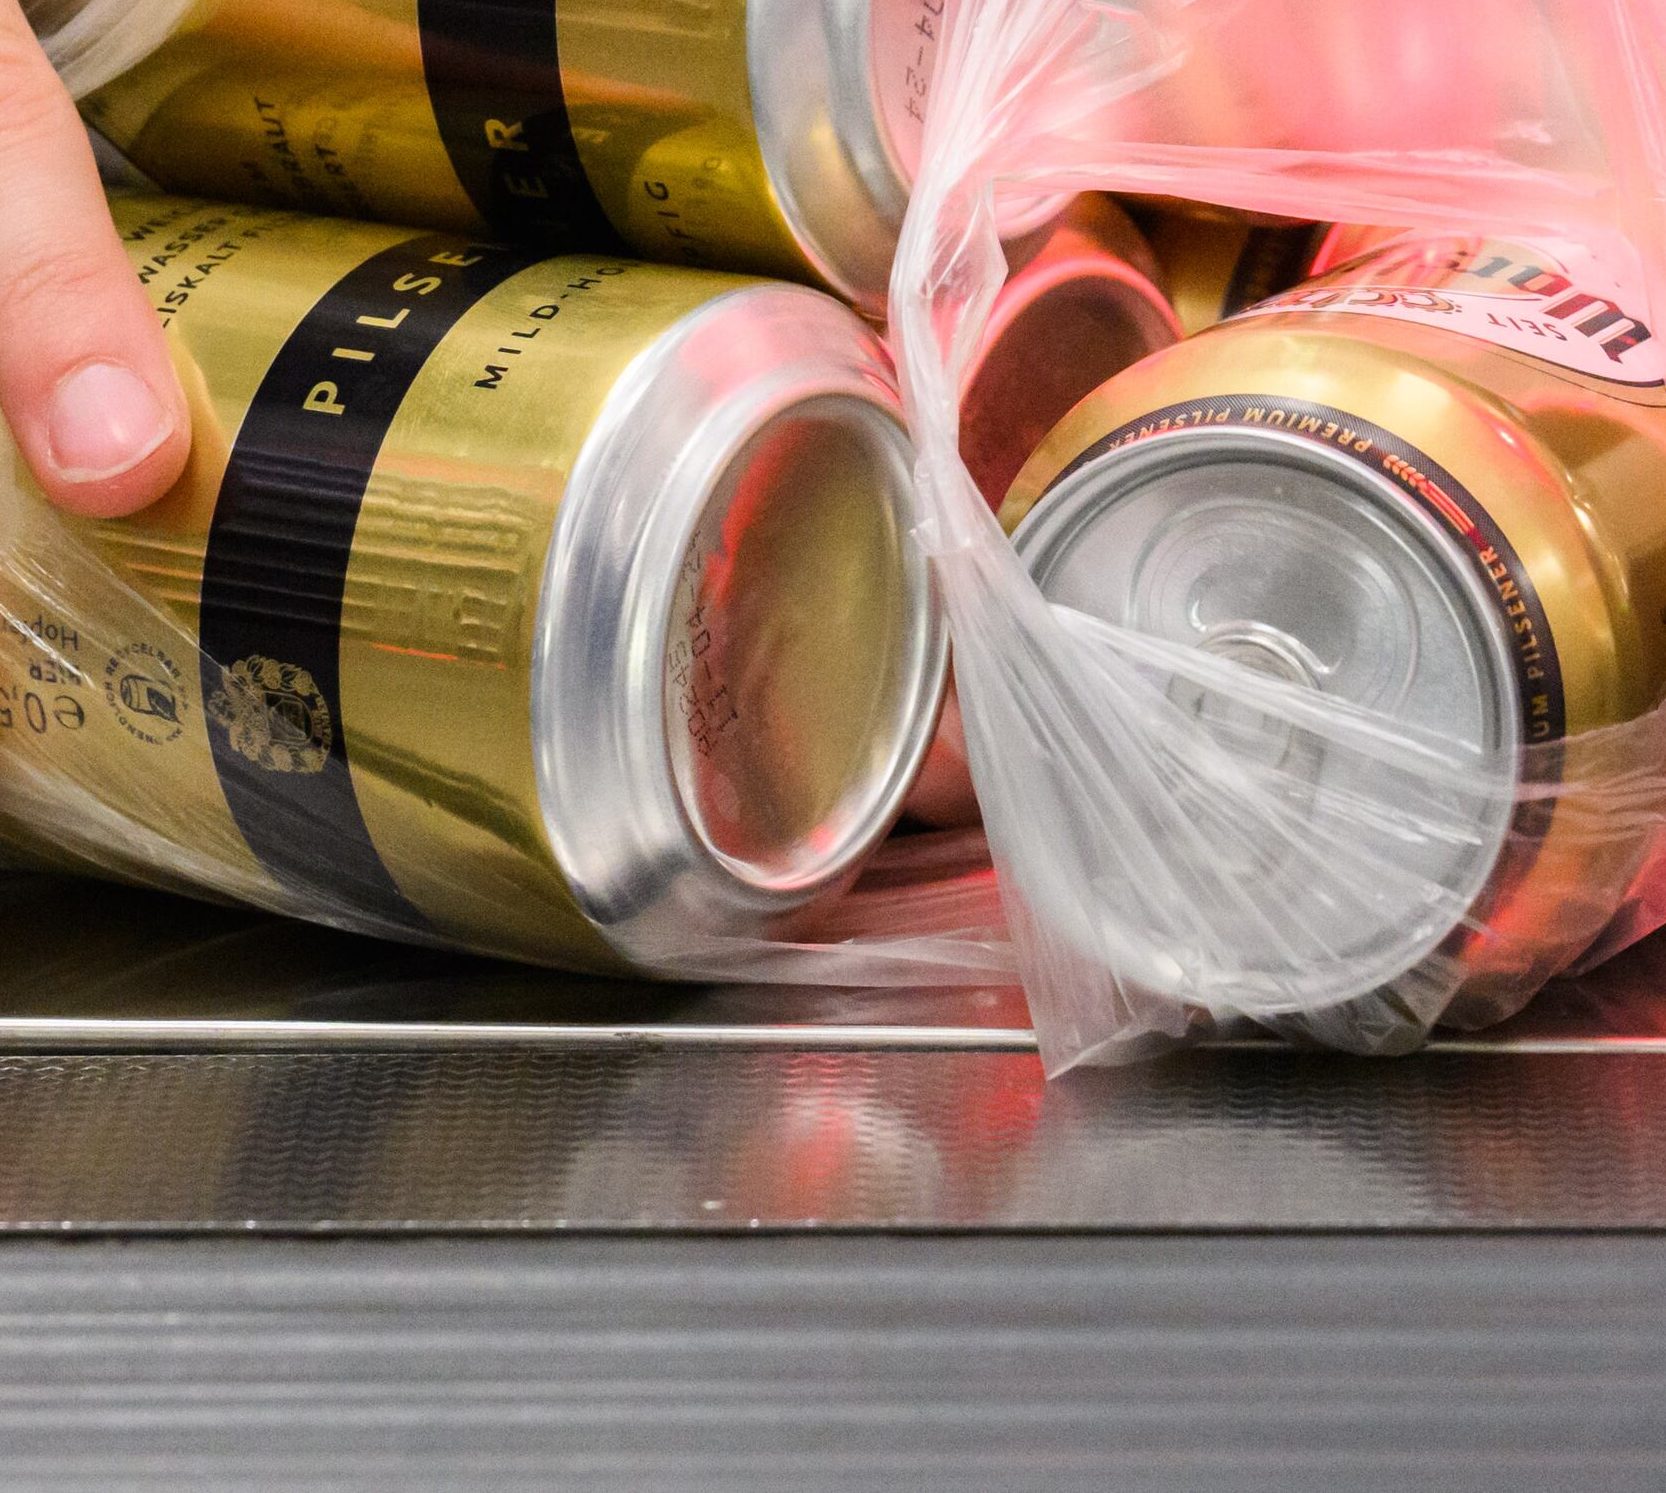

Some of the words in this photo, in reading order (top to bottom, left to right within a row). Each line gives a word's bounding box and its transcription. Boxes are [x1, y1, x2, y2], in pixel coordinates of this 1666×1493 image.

[303, 246, 501, 416] PILSE
[472, 264, 629, 390] MILD-HO
[1486, 311, 1567, 343] SEIT
[1242, 407, 1374, 452] PREMIUM
[1476, 544, 1545, 681] PILSENER
